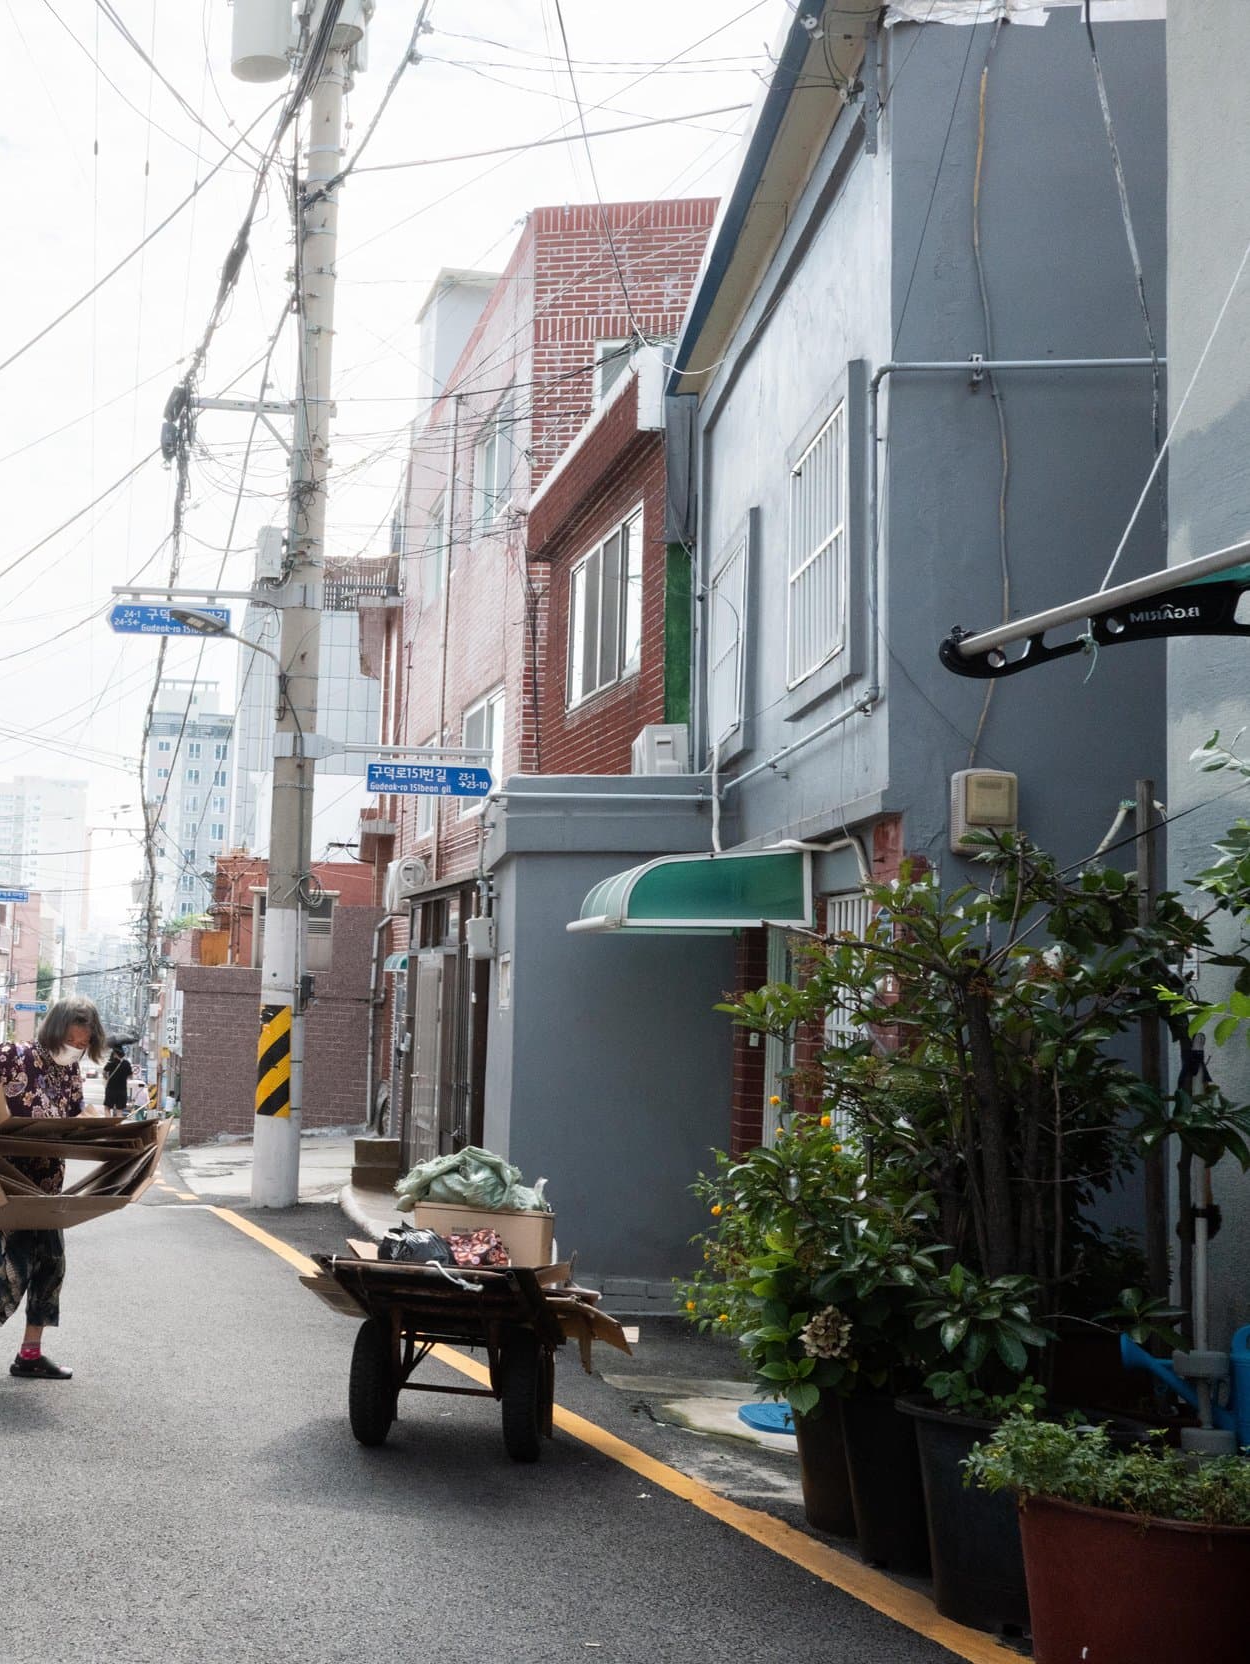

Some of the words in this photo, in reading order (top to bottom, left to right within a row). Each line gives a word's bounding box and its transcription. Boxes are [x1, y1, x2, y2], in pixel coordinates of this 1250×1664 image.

[372, 766, 447, 783] 구덕로151번길
[458, 772, 475, 781] 23-1
[466, 781, 488, 790] 23-10
